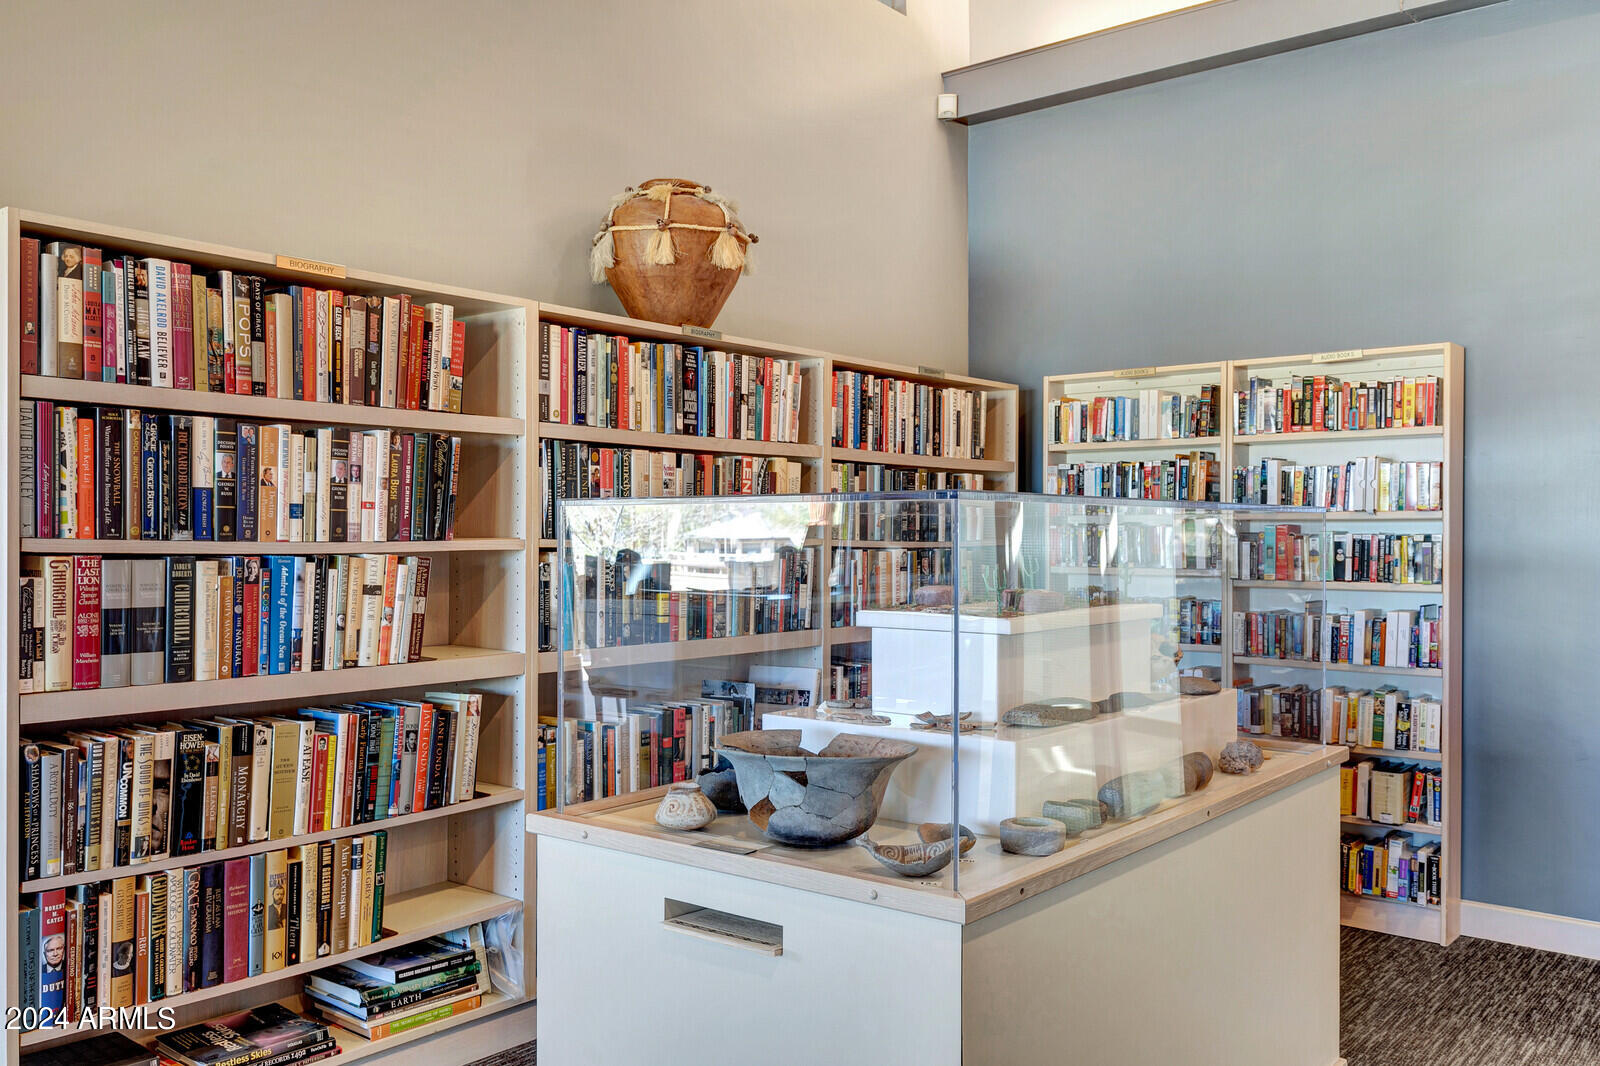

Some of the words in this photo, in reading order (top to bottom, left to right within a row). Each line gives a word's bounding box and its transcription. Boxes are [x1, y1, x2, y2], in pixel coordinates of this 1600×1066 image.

[155, 265, 166, 289] DAVID
[290, 260, 334, 273] BIOGRAPHY
[156, 292, 167, 328] AXELROD
[256, 302, 261, 312] OF
[137, 307, 149, 336] JOE'S
[238, 304, 251, 358] POPS
[370, 313, 379, 342] American
[137, 338, 150, 359] LAW
[157, 331, 167, 369] BELIEVER
[577, 335, 586, 372] HAMMER
[1321, 353, 1334, 361] AUDIO
[20, 408, 32, 440] DAVID
[178, 431, 187, 473] RICHARD
[391, 453, 400, 478] LAURA
[20, 446, 32, 500] BRINKLEY
[620, 451, 631, 497] Kennedys
[178, 473, 187, 510] BURTON
[390, 479, 399, 500] BUSH
[78, 568, 100, 576] LAST
[80, 560, 99, 568] THE
[49, 560, 71, 618] CHURCHILL
[78, 576, 100, 584] LION
[280, 566, 288, 596] Admiral
[353, 576, 359, 586] MY
[174, 584, 190, 644] CHURCHILL
[278, 598, 287, 606] of
[223, 620, 231, 663] MANSIONS
[279, 621, 287, 643] Ocean
[359, 719, 367, 739] Carly
[423, 710, 431, 735] JANE
[140, 743, 152, 756] THE
[180, 741, 205, 749] HOWER
[303, 745, 312, 757] AT
[358, 742, 366, 770] Fiorina
[420, 737, 429, 773] FONDA
[137, 760, 153, 785] SOUND
[302, 760, 310, 783] EASE
[435, 743, 444, 777] FONDA
[31, 764, 40, 808] SHADOWS
[49, 771, 58, 799] ROYAL
[119, 762, 132, 818] UNCOMMON
[139, 788, 151, 799] OF
[236, 766, 249, 829] MONARCHY
[49, 801, 57, 818] DUTY
[138, 801, 150, 825] WINGS
[30, 823, 39, 864] PRINCESS
[322, 847, 331, 866] HANK
[342, 844, 350, 867] Alan
[169, 875, 177, 920] APOLOGIES
[188, 871, 200, 911] GRACE
[321, 867, 331, 904] GREENBERG
[337, 868, 348, 919] Greenspan
[44, 904, 65, 912] ROBERT
[151, 877, 167, 939] GOLDWATER
[289, 918, 299, 947] Them
[169, 926, 177, 975] GOLDWATER
[42, 981, 65, 992] DUTY
[391, 992, 423, 1009] EARTH
[250, 1048, 272, 1061] Skies
